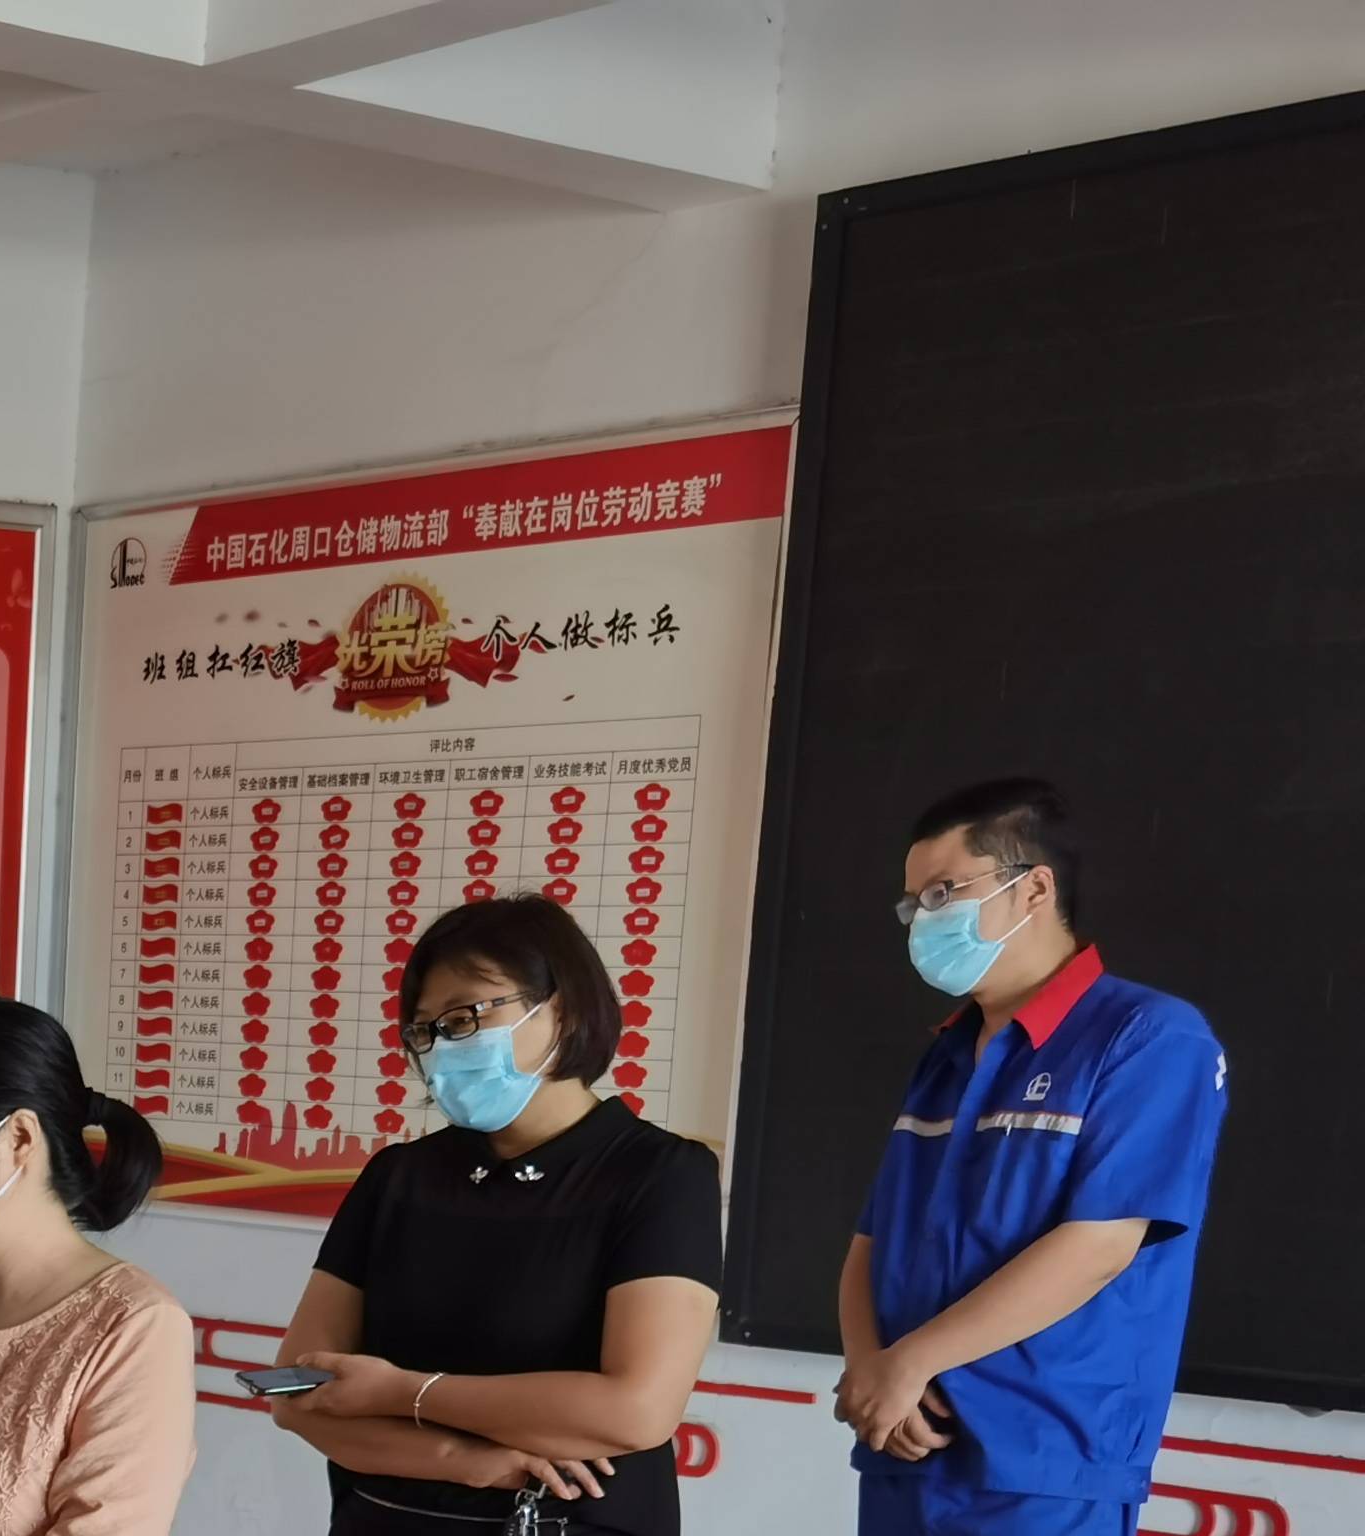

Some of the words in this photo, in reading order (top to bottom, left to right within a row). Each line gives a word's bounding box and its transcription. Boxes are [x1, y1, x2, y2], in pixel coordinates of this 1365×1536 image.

[482, 603, 681, 662] 个人做标兵
[336, 613, 453, 678] 光荣榜
[142, 638, 302, 686] 班组扛红旗
[351, 680, 375, 691] ROLL
[377, 679, 389, 688] OF
[391, 676, 427, 688] HONOR
[430, 737, 476, 754] 评比内容
[193, 765, 232, 781] 个人标兵
[454, 765, 525, 783] 职工宿舍管理
[534, 760, 607, 779] 业务技能考试
[616, 756, 692, 776] 月度优秀党员
[123, 770, 142, 783] 月份
[155, 769, 179, 782] 班组
[238, 775, 299, 792] 安全设备管理
[307, 772, 370, 789] 基础档案管理
[379, 768, 446, 785] 环境卫生管理
[128, 811, 133, 822] 1
[190, 806, 229, 820] 个人标兵
[126, 837, 132, 848] 2
[188, 833, 228, 848] 个人标兵
[125, 864, 131, 875] 3
[187, 860, 226, 875] 个人标兵
[123, 889, 130, 900] 4
[185, 887, 225, 903] 个人标兵
[122, 916, 128, 927] 5
[184, 914, 223, 929] 个人标兵
[121, 943, 127, 954] 6
[183, 942, 222, 956] 个人标兵
[120, 969, 126, 979] 7
[182, 968, 220, 983] 个人标兵
[119, 995, 125, 1006] 8
[181, 993, 220, 1009] 个人标兵
[117, 1021, 123, 1032] 9
[180, 1021, 218, 1037] 个人标兵
[114, 1047, 126, 1058] 10
[179, 1048, 217, 1063] 个人标兵
[113, 1073, 124, 1083] 11
[177, 1074, 216, 1089] 个人标兵
[175, 1100, 214, 1115] 个人标兵
